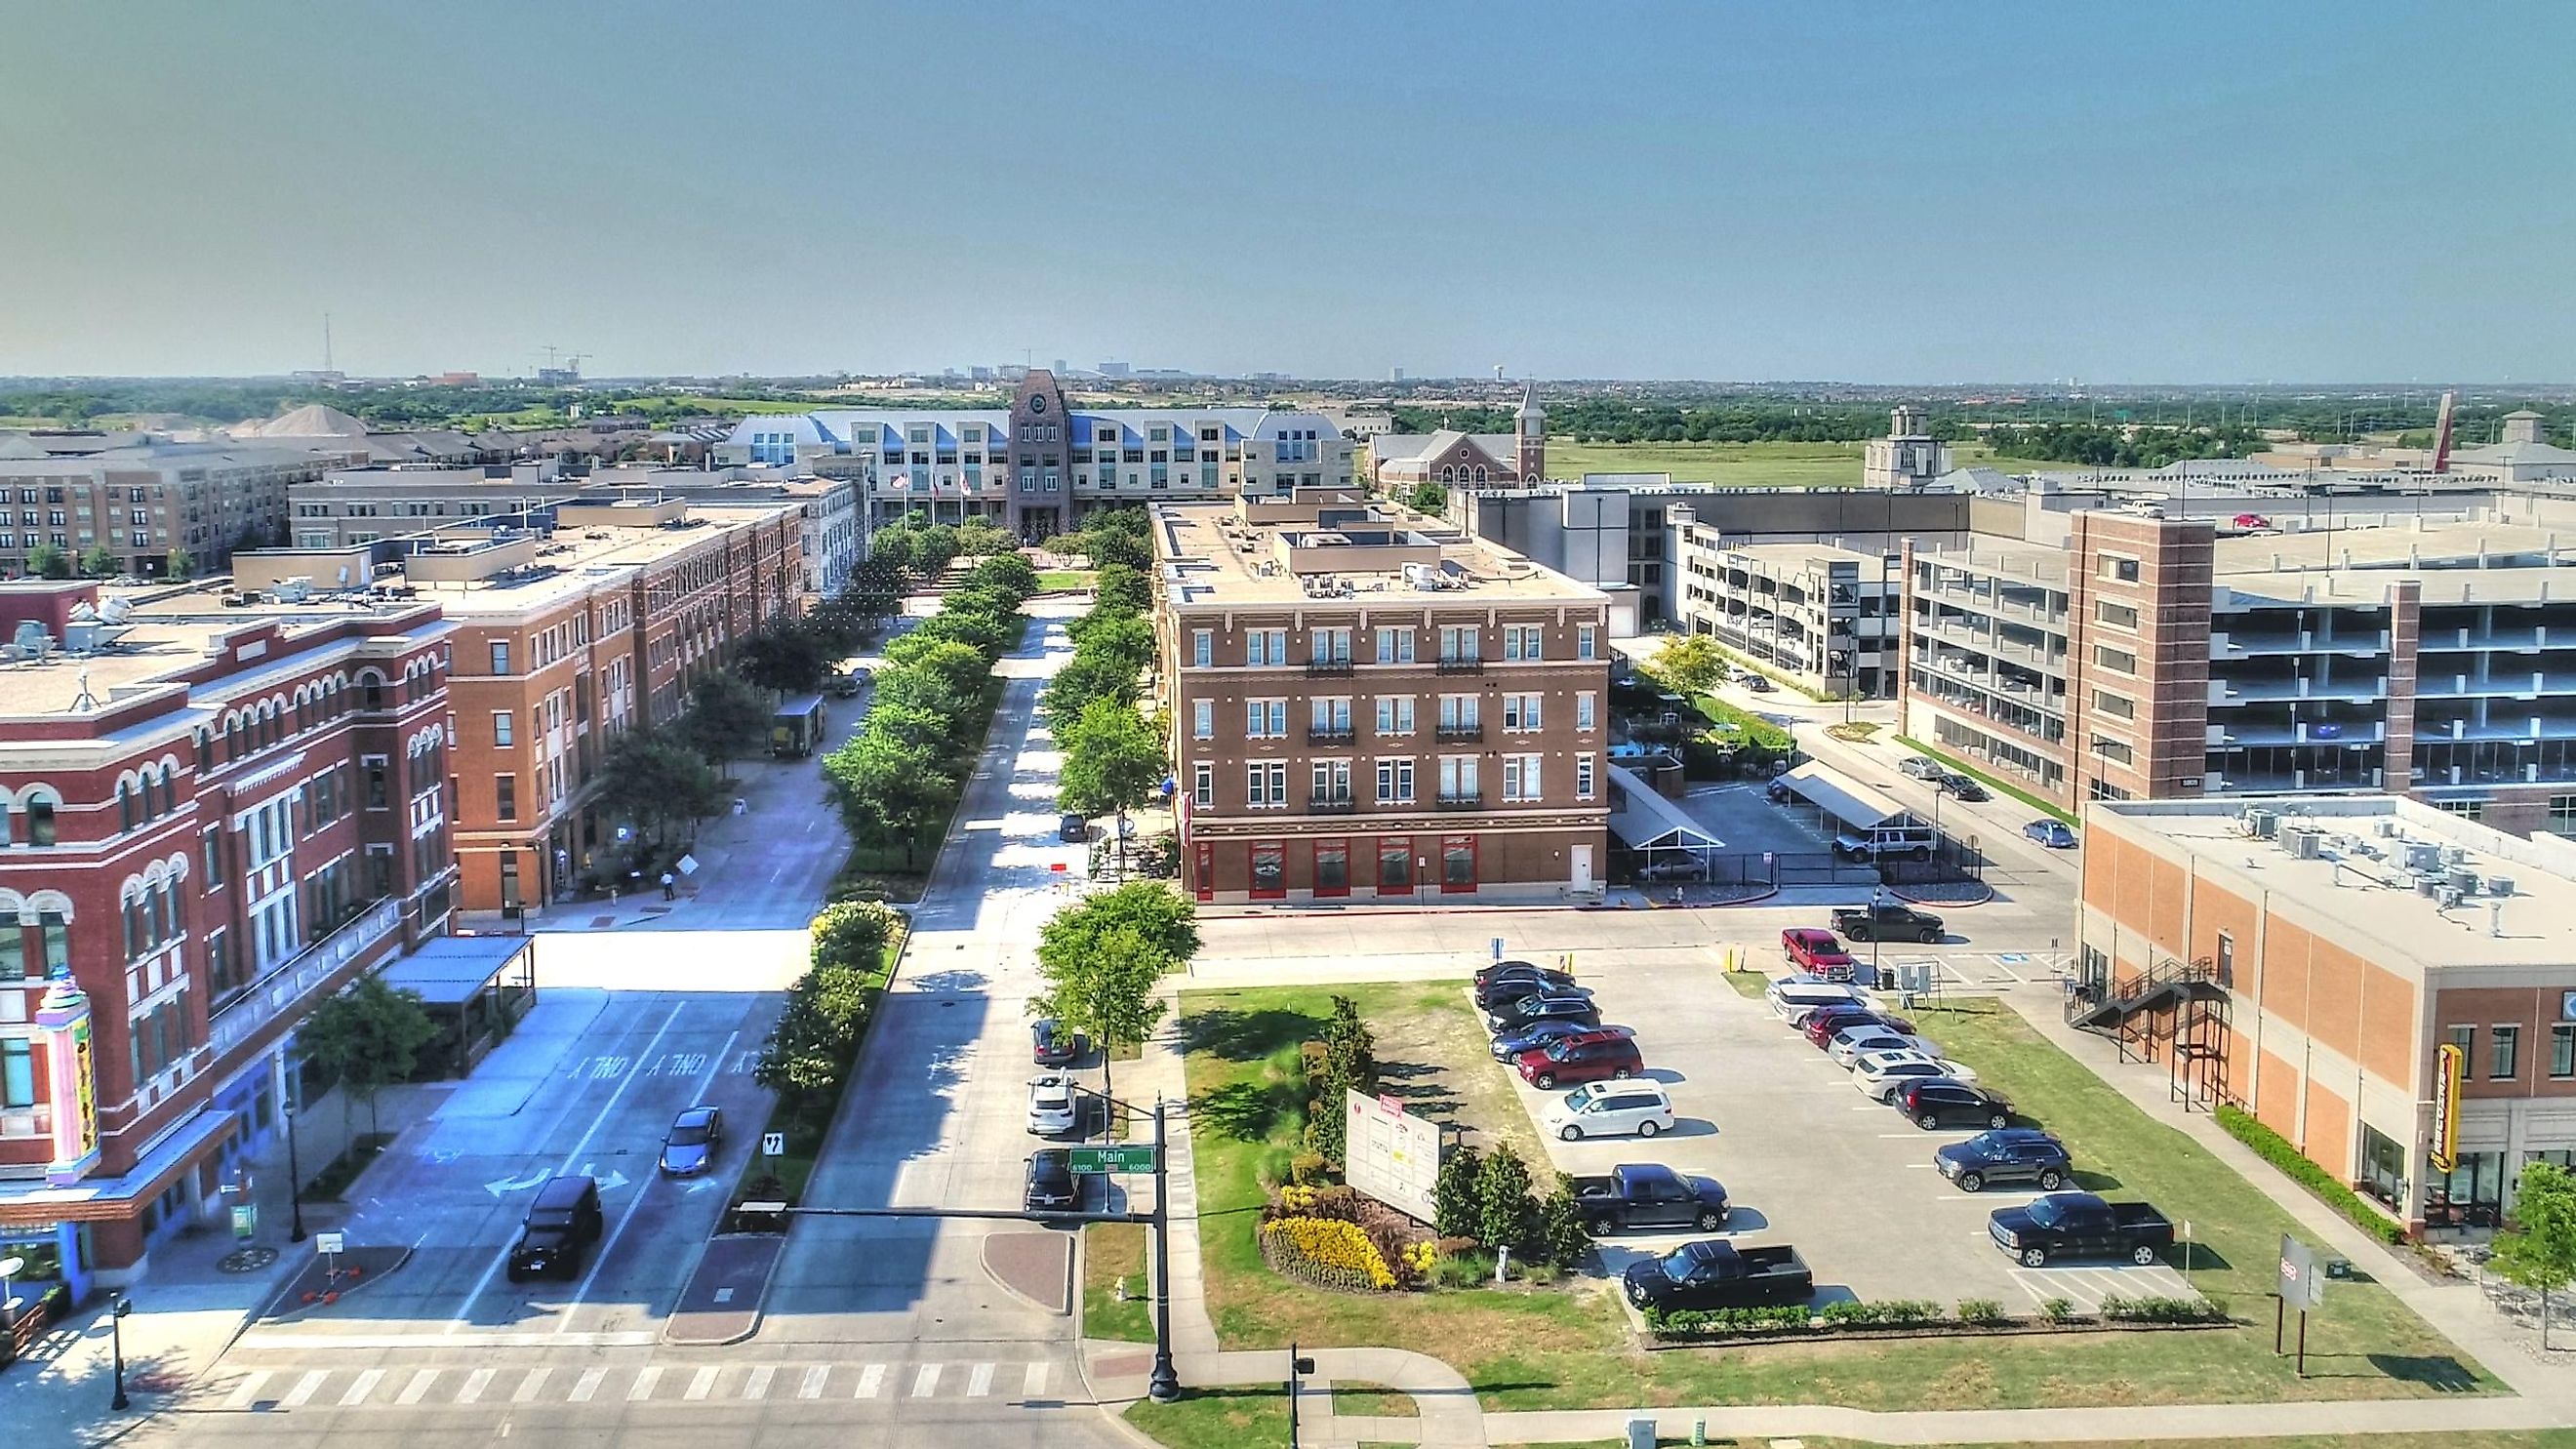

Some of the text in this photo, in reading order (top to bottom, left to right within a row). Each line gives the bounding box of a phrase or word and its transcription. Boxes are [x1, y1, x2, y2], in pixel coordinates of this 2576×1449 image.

[567, 1057, 629, 1079] ONLY
[647, 1054, 707, 1076] ONLY
[1097, 1150, 1125, 1163] Main
